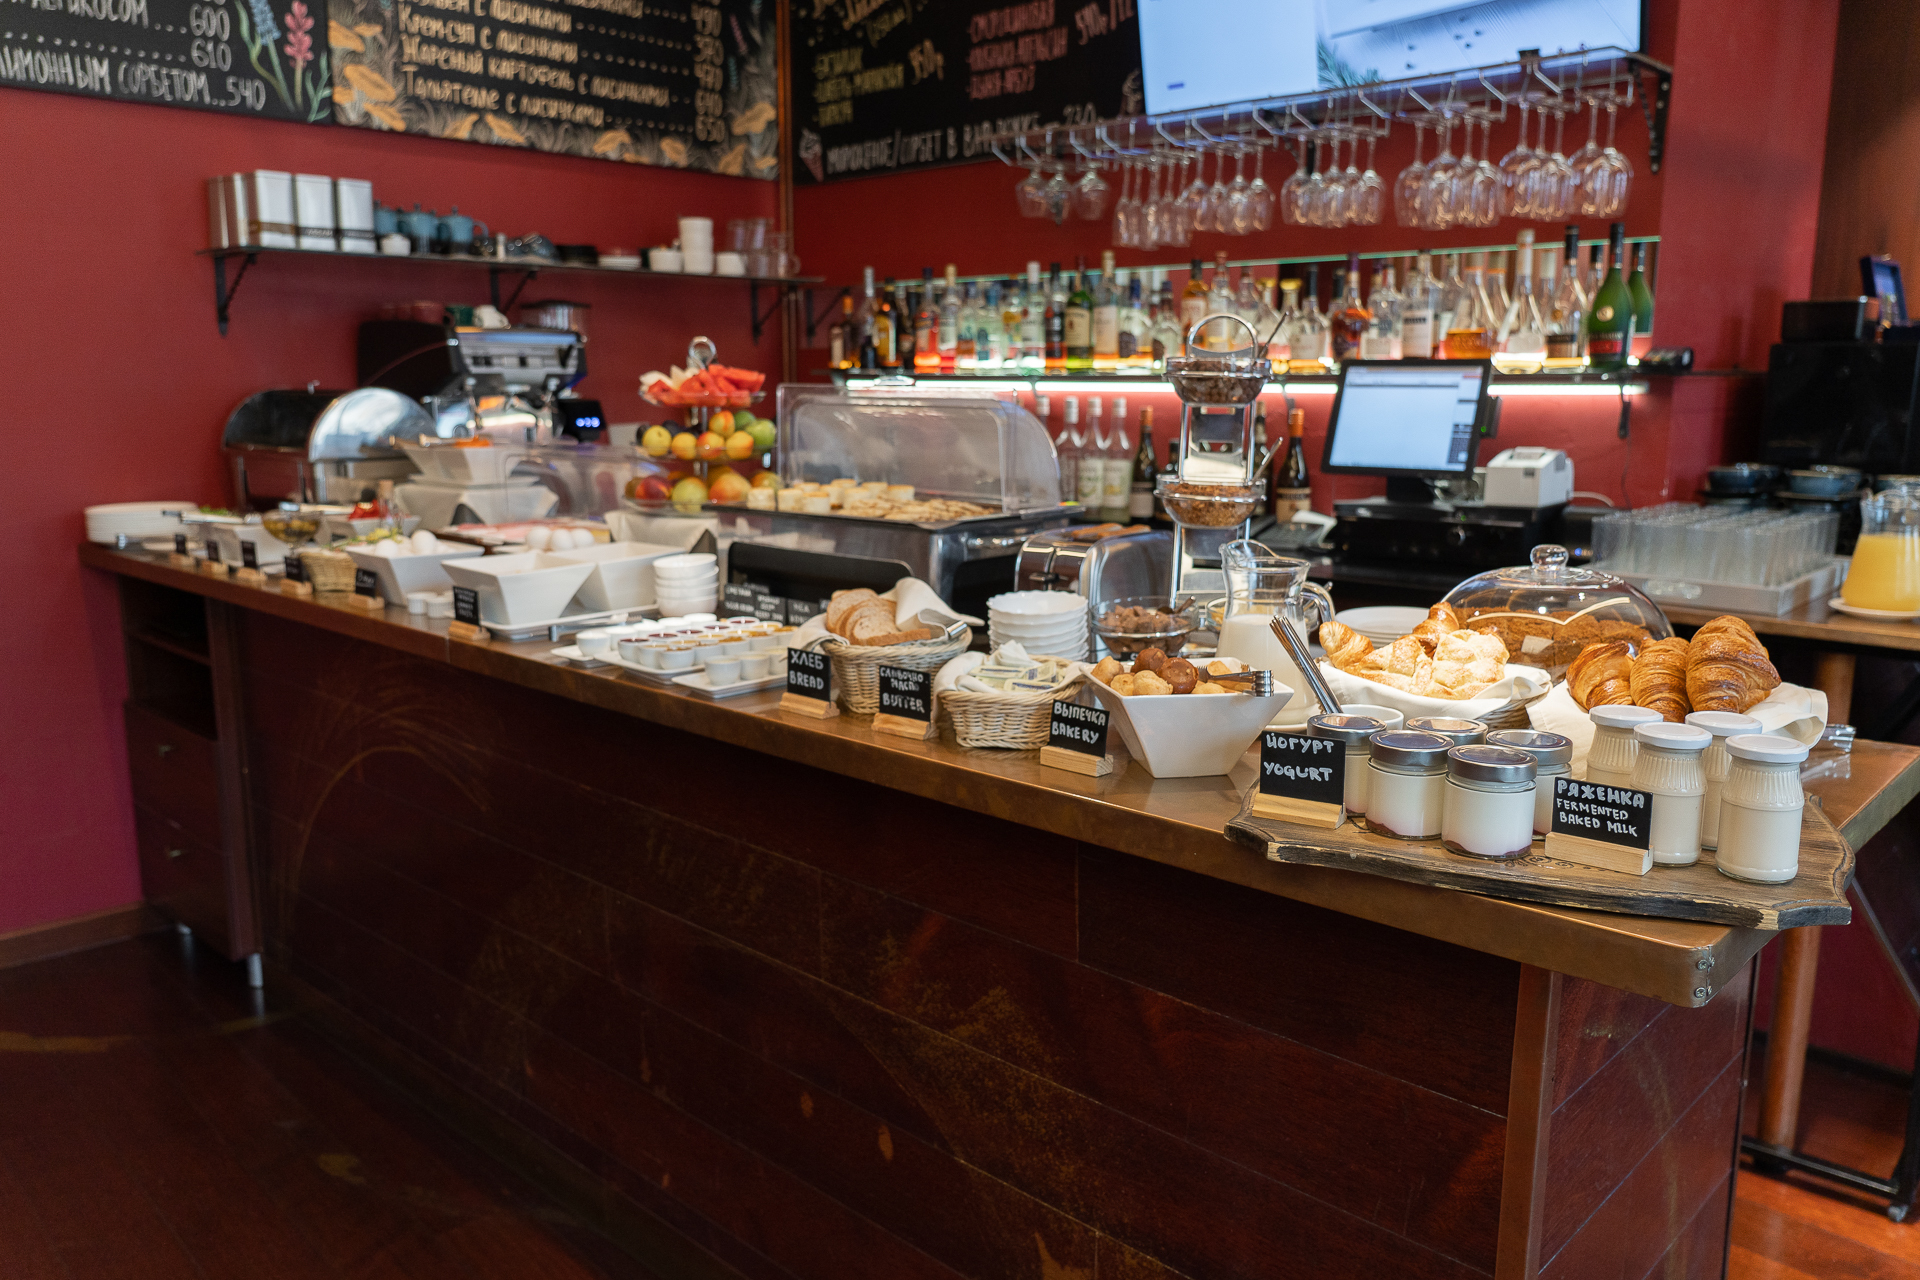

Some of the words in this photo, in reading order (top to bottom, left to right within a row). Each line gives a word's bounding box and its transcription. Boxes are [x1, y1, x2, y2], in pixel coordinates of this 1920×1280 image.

[189, 3, 230, 41] 600
[191, 37, 231, 72] 610
[118, 60, 210, 104] СОРБЕТОМ
[226, 76, 266, 111] 540
[790, 650, 824, 670] ХЛЕБ
[789, 670, 824, 690] BREAD
[882, 692, 925, 714] BUTTER
[1053, 701, 1107, 727] ВЫПЕЧКА
[1051, 720, 1099, 744] BAKERY
[1265, 732, 1335, 754] ЙОГУРТ
[1264, 761, 1332, 782] YOGURT
[1557, 779, 1645, 809] РЯЖЕНКА
[1556, 798, 1628, 820] FERMENTED
[1559, 811, 1600, 828] BAKED
[1606, 820, 1638, 837] MILK
